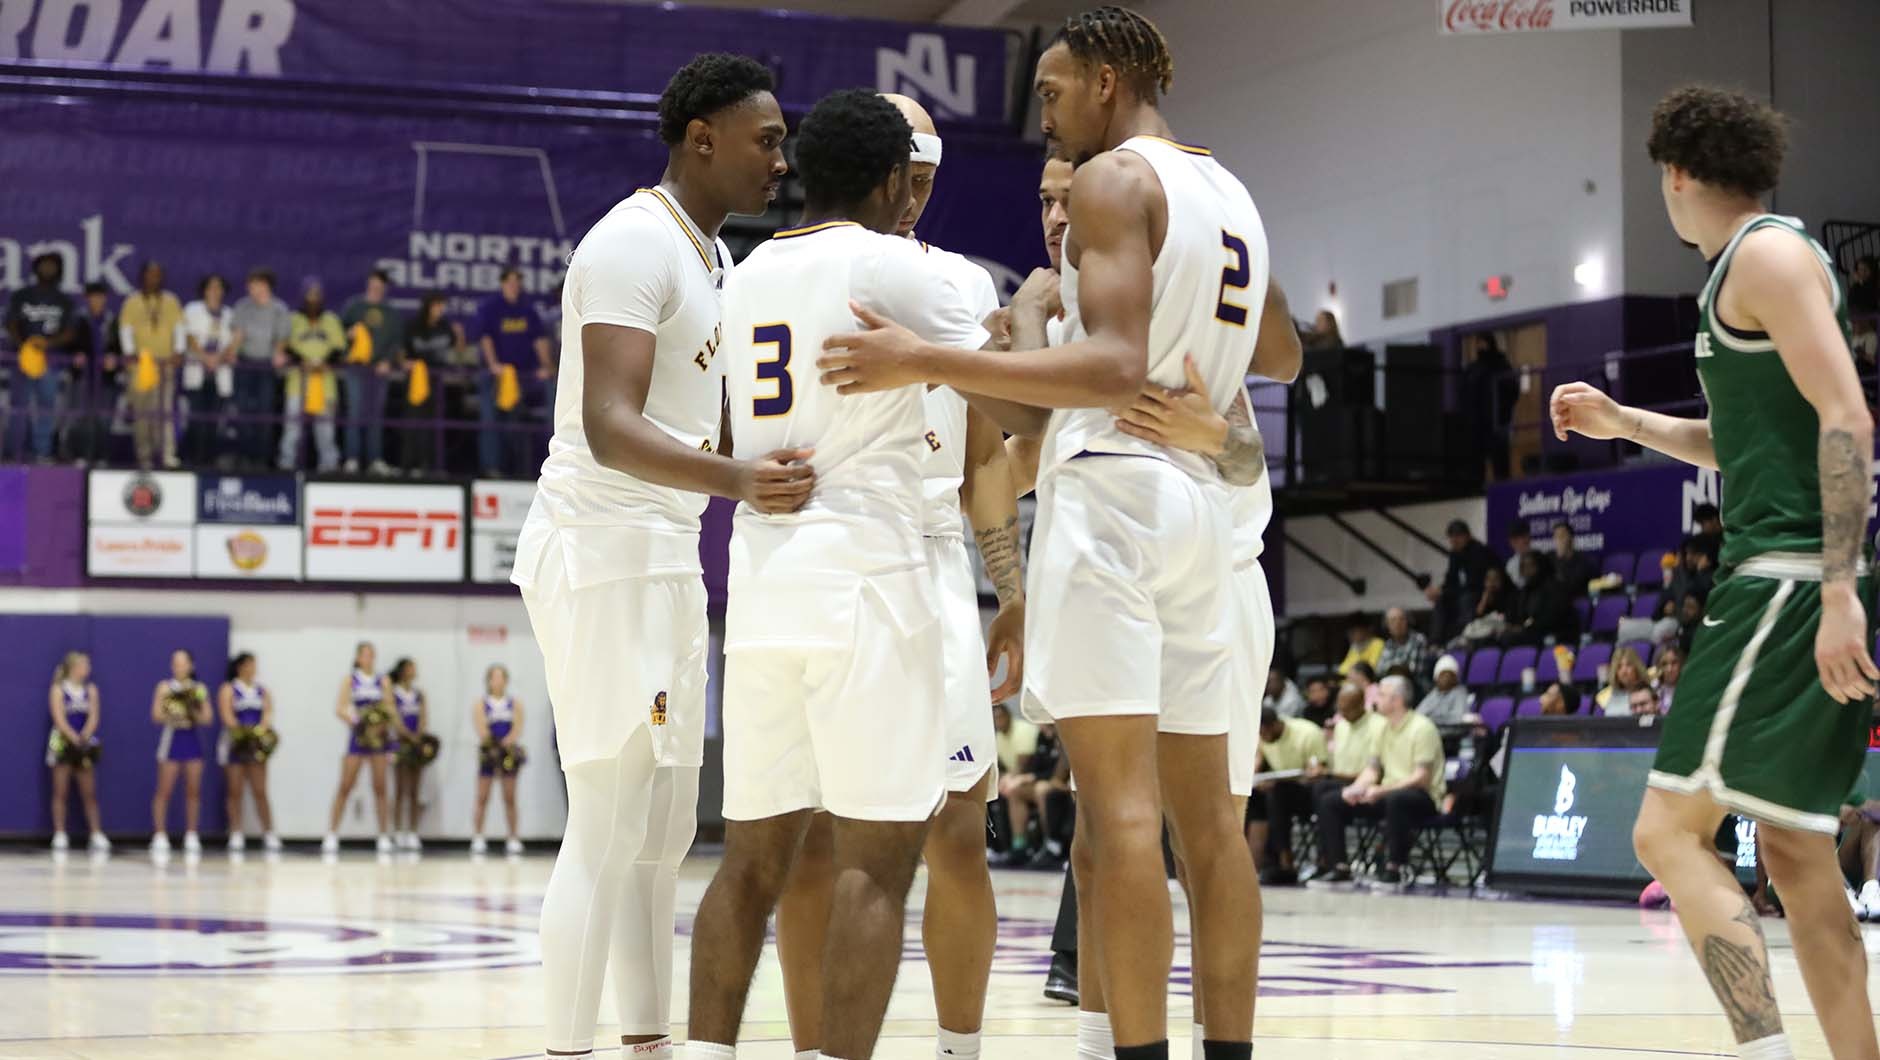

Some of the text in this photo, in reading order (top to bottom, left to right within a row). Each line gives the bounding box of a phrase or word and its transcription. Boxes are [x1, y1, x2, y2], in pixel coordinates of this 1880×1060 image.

[1215, 227, 1250, 328] 2
[752, 321, 795, 418] 3
[311, 510, 459, 549] ESPN
